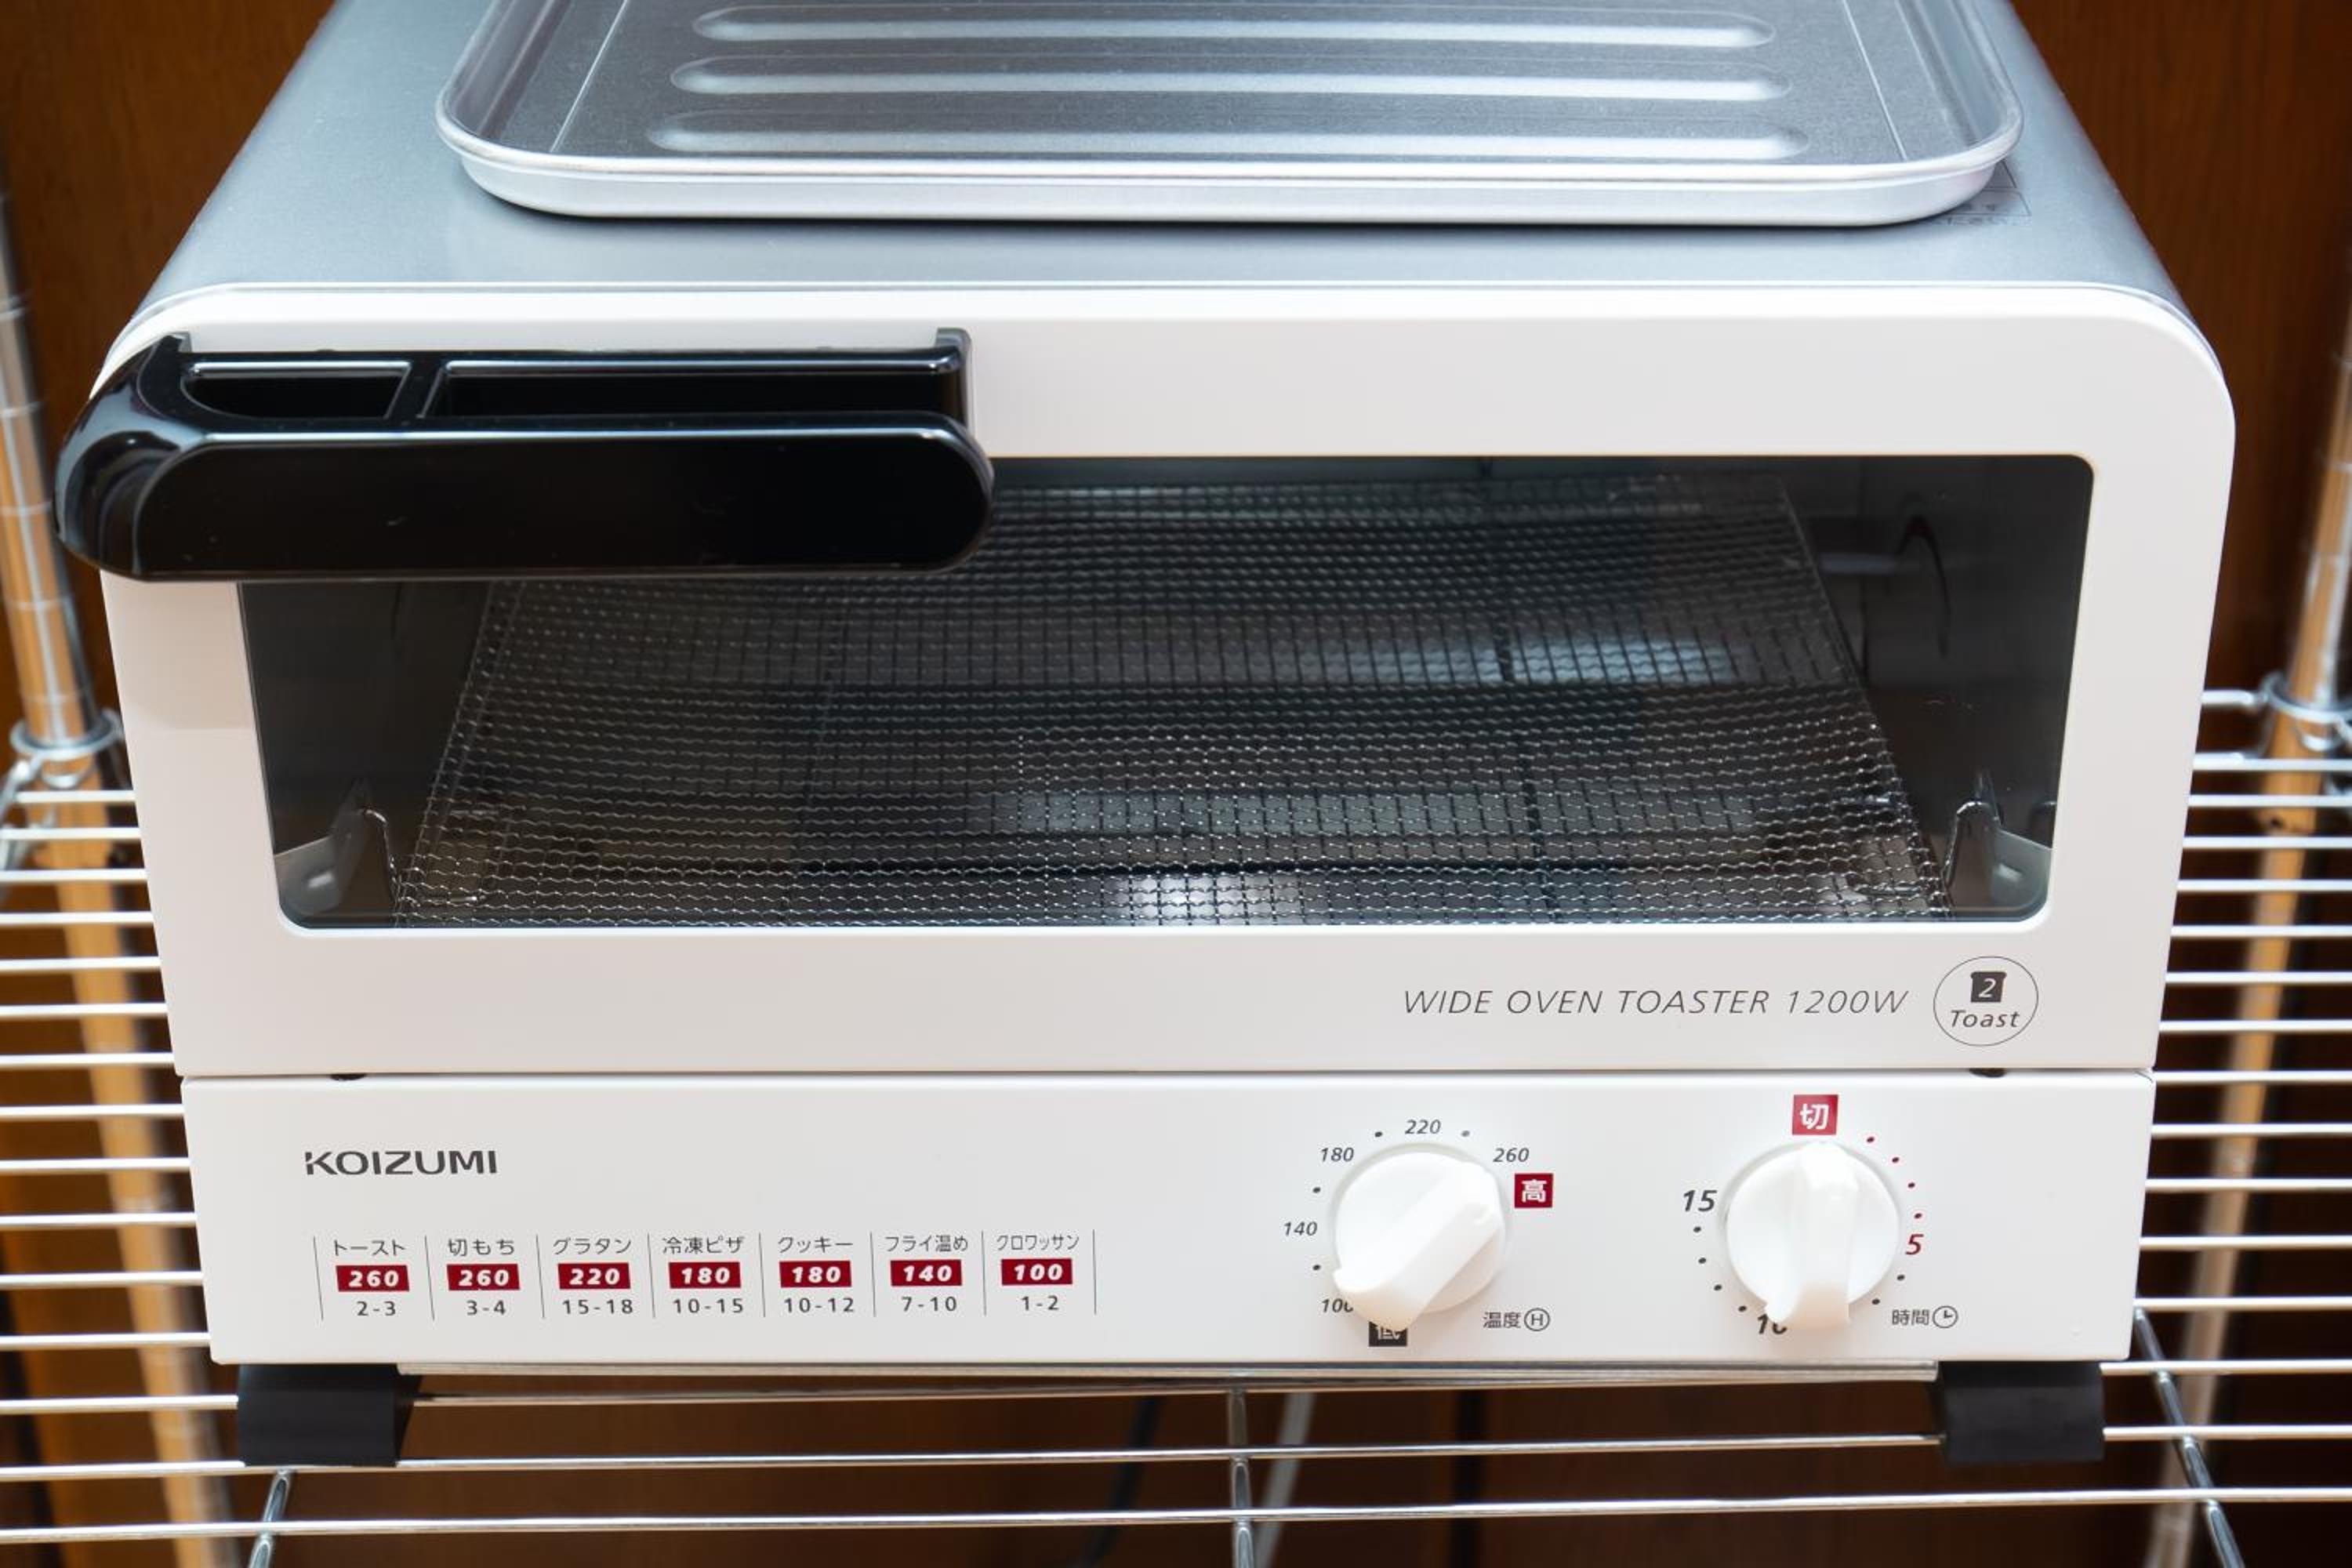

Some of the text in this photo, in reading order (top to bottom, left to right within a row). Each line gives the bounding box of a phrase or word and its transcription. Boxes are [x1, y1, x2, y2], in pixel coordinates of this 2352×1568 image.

[1979, 978, 1996, 997] 2
[1405, 990, 1909, 1014] WIDE OVEN TOASTER 1200W
[1950, 1009, 2020, 1029] Toast
[1800, 1104, 1828, 1130] 切
[1405, 1120, 1441, 1134] 220
[1321, 1147, 1354, 1162] 180
[1493, 1148, 1529, 1162] 260
[305, 1151, 497, 1175] KOIZUMI
[1522, 1179, 1546, 1202] 高
[1682, 1189, 1717, 1212] 15
[1284, 1221, 1317, 1236] 140
[334, 1240, 405, 1256] トースト
[448, 1239, 514, 1257] 切もち
[554, 1237, 631, 1254] グラタン
[662, 1236, 744, 1254] 冷凍ピザ
[778, 1236, 853, 1253] クッキー
[885, 1235, 967, 1252] フライ温め
[997, 1234, 1079, 1250] クロワッサン
[1905, 1234, 1924, 1255] 5
[349, 1270, 398, 1287] 260
[459, 1270, 509, 1286] 260
[570, 1269, 619, 1285] 220
[682, 1268, 730, 1283] 180
[793, 1267, 840, 1283] 180
[904, 1265, 952, 1281] 140
[1014, 1264, 1062, 1280] 100
[358, 1301, 395, 1316] 2-3
[467, 1300, 506, 1316] 3-4
[563, 1299, 633, 1314] 15-18
[673, 1298, 743, 1313] 10-15
[784, 1298, 853, 1312] 10-12
[902, 1296, 956, 1312] 7-10
[1022, 1295, 1058, 1311] 1-2
[1483, 1312, 1521, 1328] 温度
[1892, 1309, 1929, 1326] 時間
